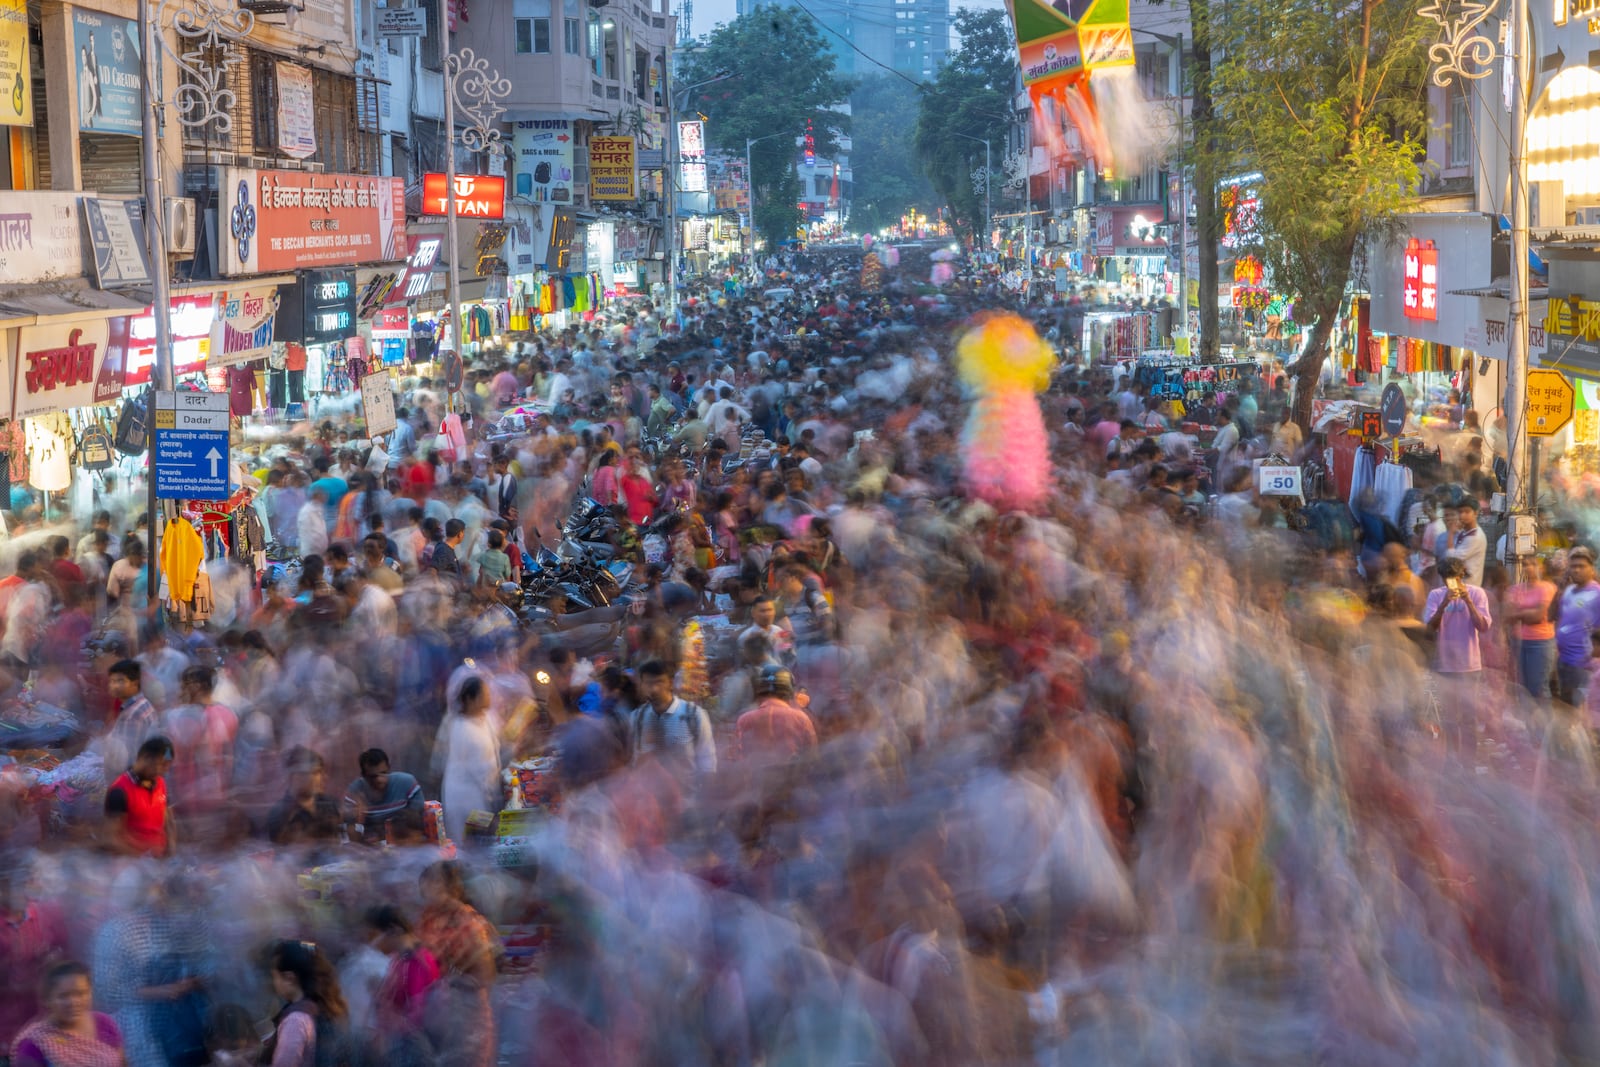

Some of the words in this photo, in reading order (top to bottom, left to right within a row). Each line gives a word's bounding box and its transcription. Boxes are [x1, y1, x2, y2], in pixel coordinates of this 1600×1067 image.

[518, 120, 568, 130] SUVIDHA
[591, 138, 631, 151] हॉटेल
[590, 152, 631, 163] मनहर
[262, 176, 271, 209] दि
[438, 198, 489, 215] TTAN
[271, 238, 282, 250] THE
[284, 237, 304, 248] DECCAN
[306, 235, 334, 247] MERCHANTS
[351, 234, 362, 245] BANK
[185, 395, 208, 405] दादर
[183, 415, 212, 424] Dadar
